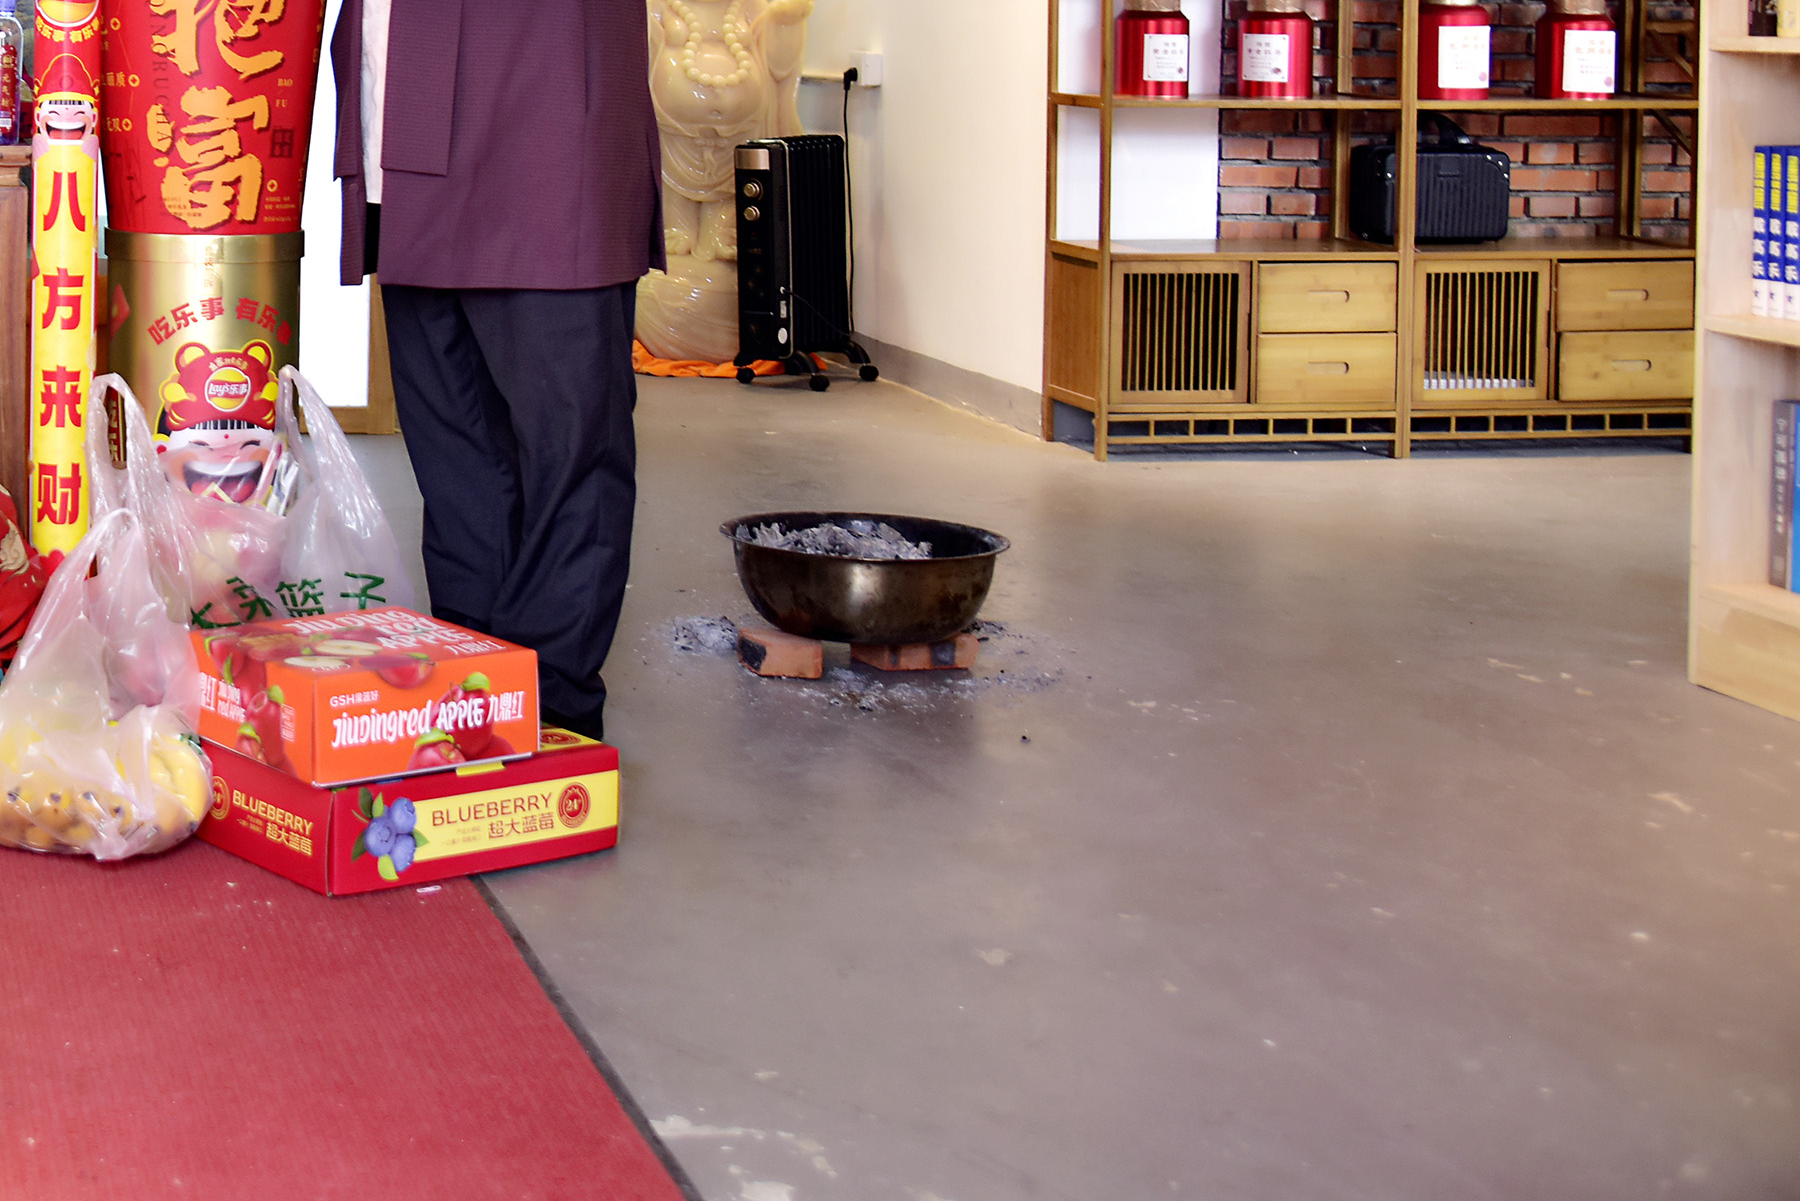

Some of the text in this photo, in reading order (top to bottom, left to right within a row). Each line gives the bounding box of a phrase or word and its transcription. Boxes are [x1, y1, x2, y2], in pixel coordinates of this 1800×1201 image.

[278, 78, 293, 88] BAO
[275, 98, 288, 108] FU
[147, 296, 225, 345] 吃乐事
[37, 171, 87, 526] 八方来财
[233, 789, 313, 836] BLUEBERRY
[432, 792, 553, 827] BLUEBERRY
[488, 812, 555, 839] 超大蓝莓
